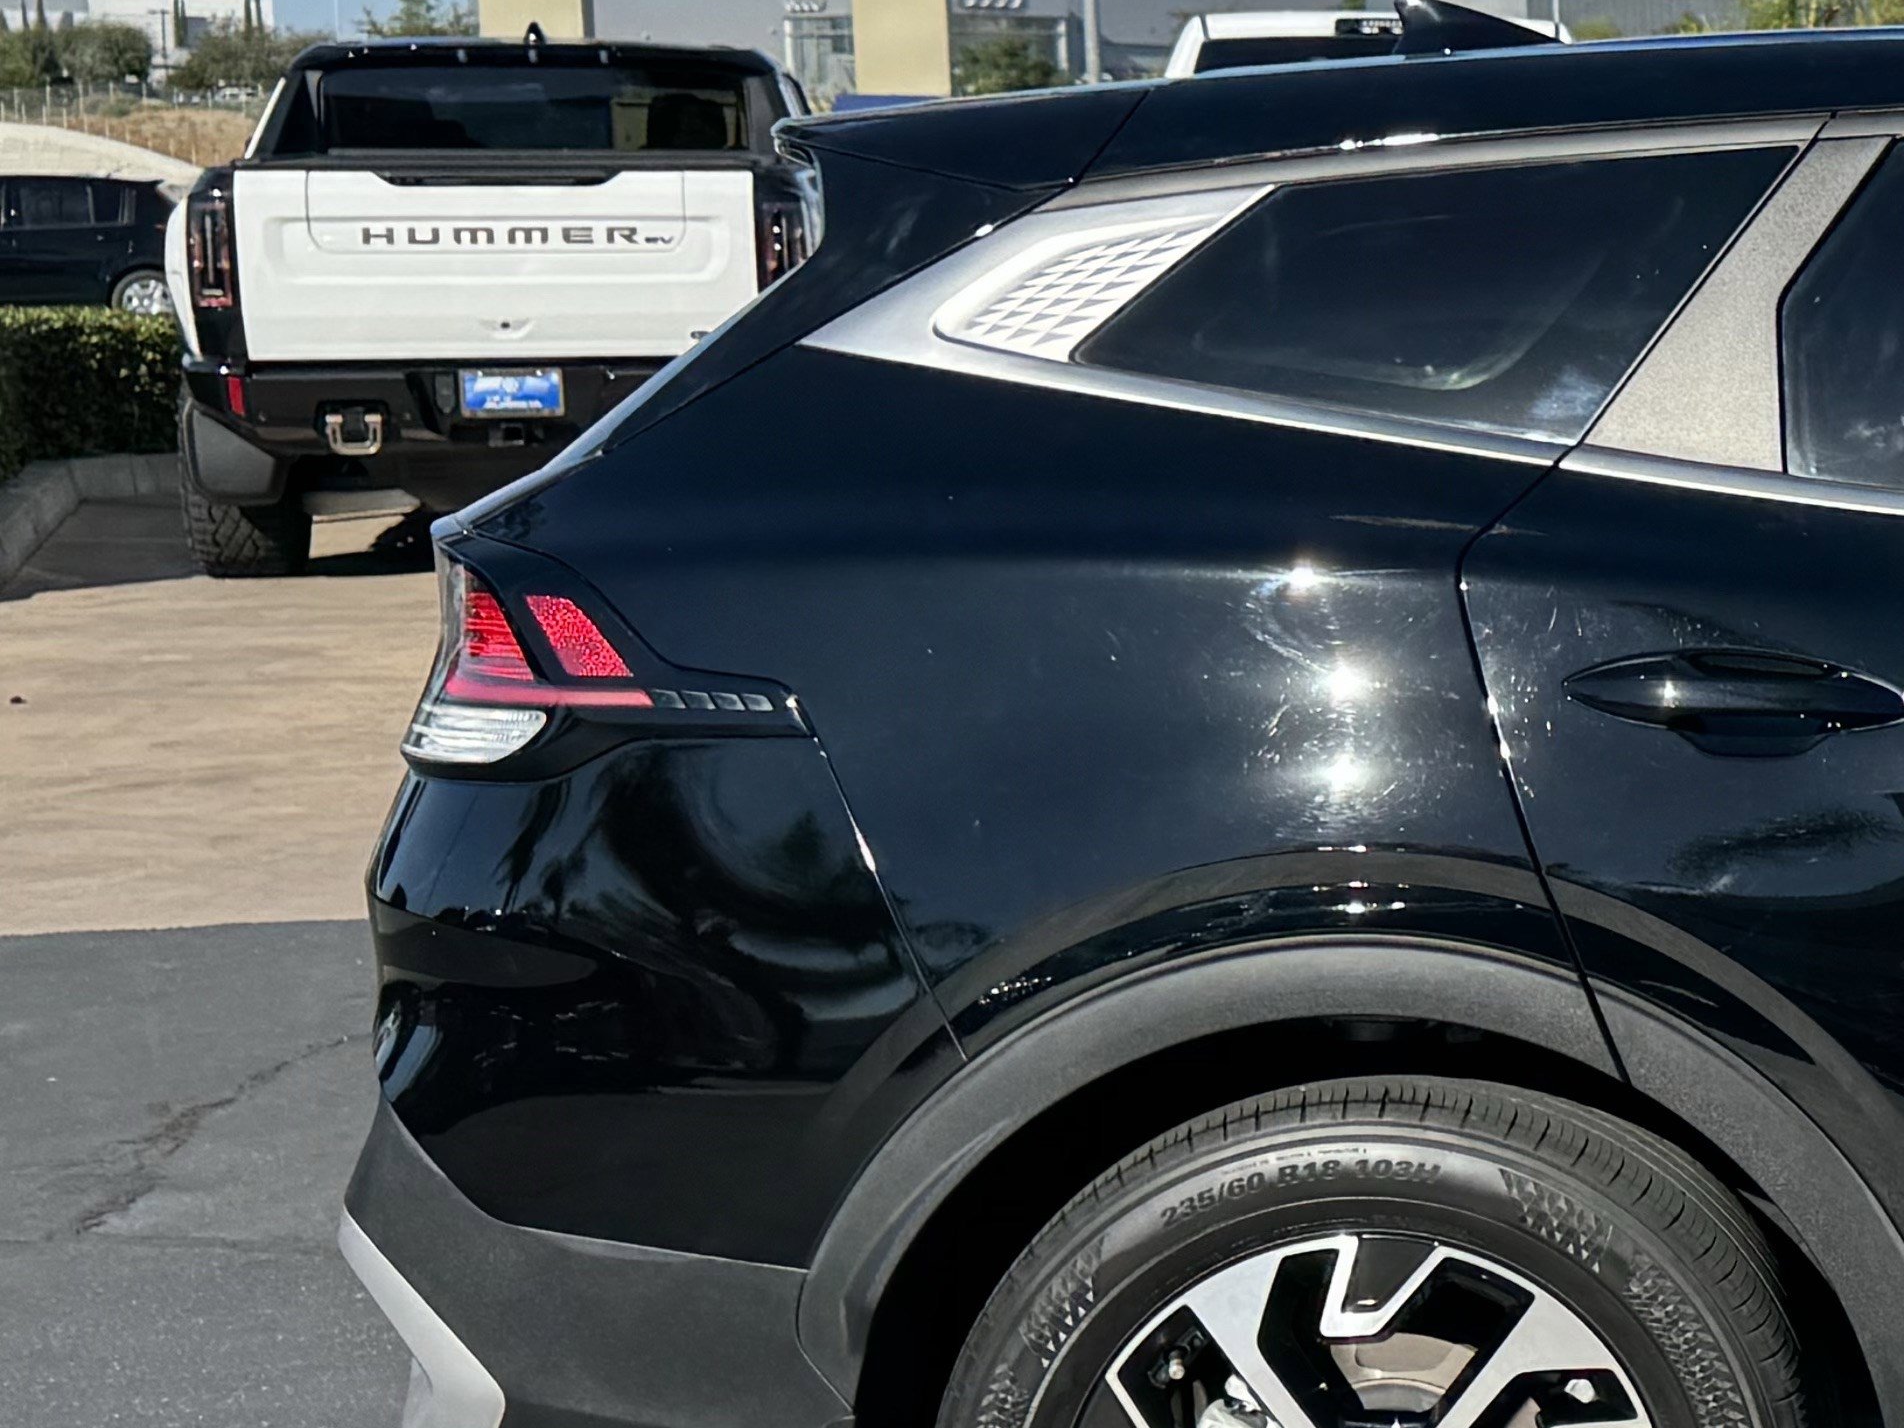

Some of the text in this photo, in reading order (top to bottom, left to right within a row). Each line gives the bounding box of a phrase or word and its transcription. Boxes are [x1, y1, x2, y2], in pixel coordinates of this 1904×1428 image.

[361, 226, 638, 245] HUMMER
[1160, 1172, 1266, 1226] 235/60
[1276, 1158, 1342, 1187] R18
[1354, 1158, 1441, 1184] 103H
